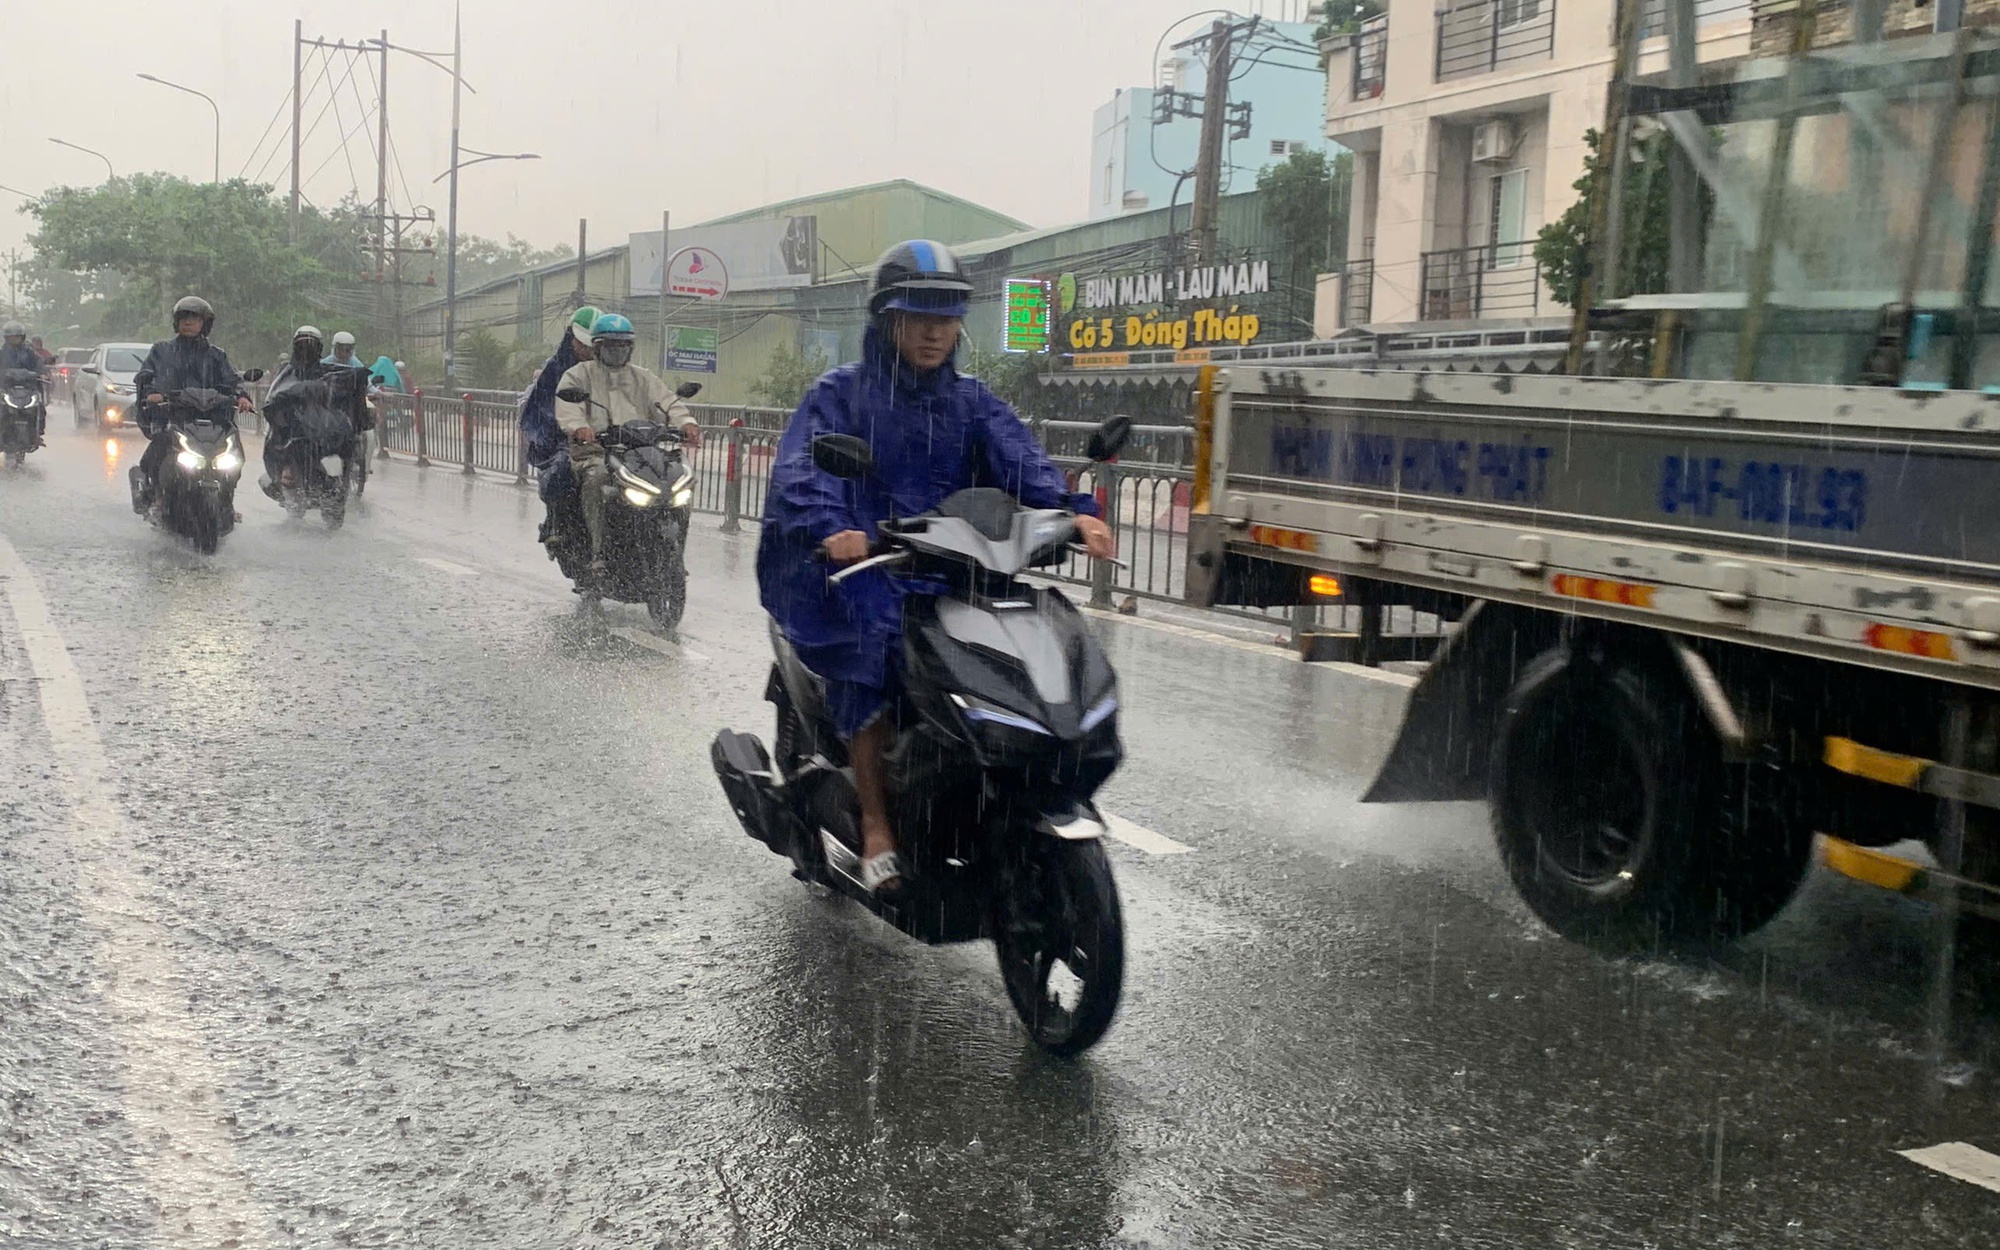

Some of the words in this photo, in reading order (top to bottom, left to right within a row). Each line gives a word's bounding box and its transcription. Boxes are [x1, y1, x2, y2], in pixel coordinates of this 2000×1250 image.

[1217, 248, 1268, 296] MẮM
[1070, 317, 1096, 349] Cô
[1100, 318, 1113, 347] 5
[1127, 309, 1187, 349] Đồng
[1194, 304, 1259, 346] Tháp
